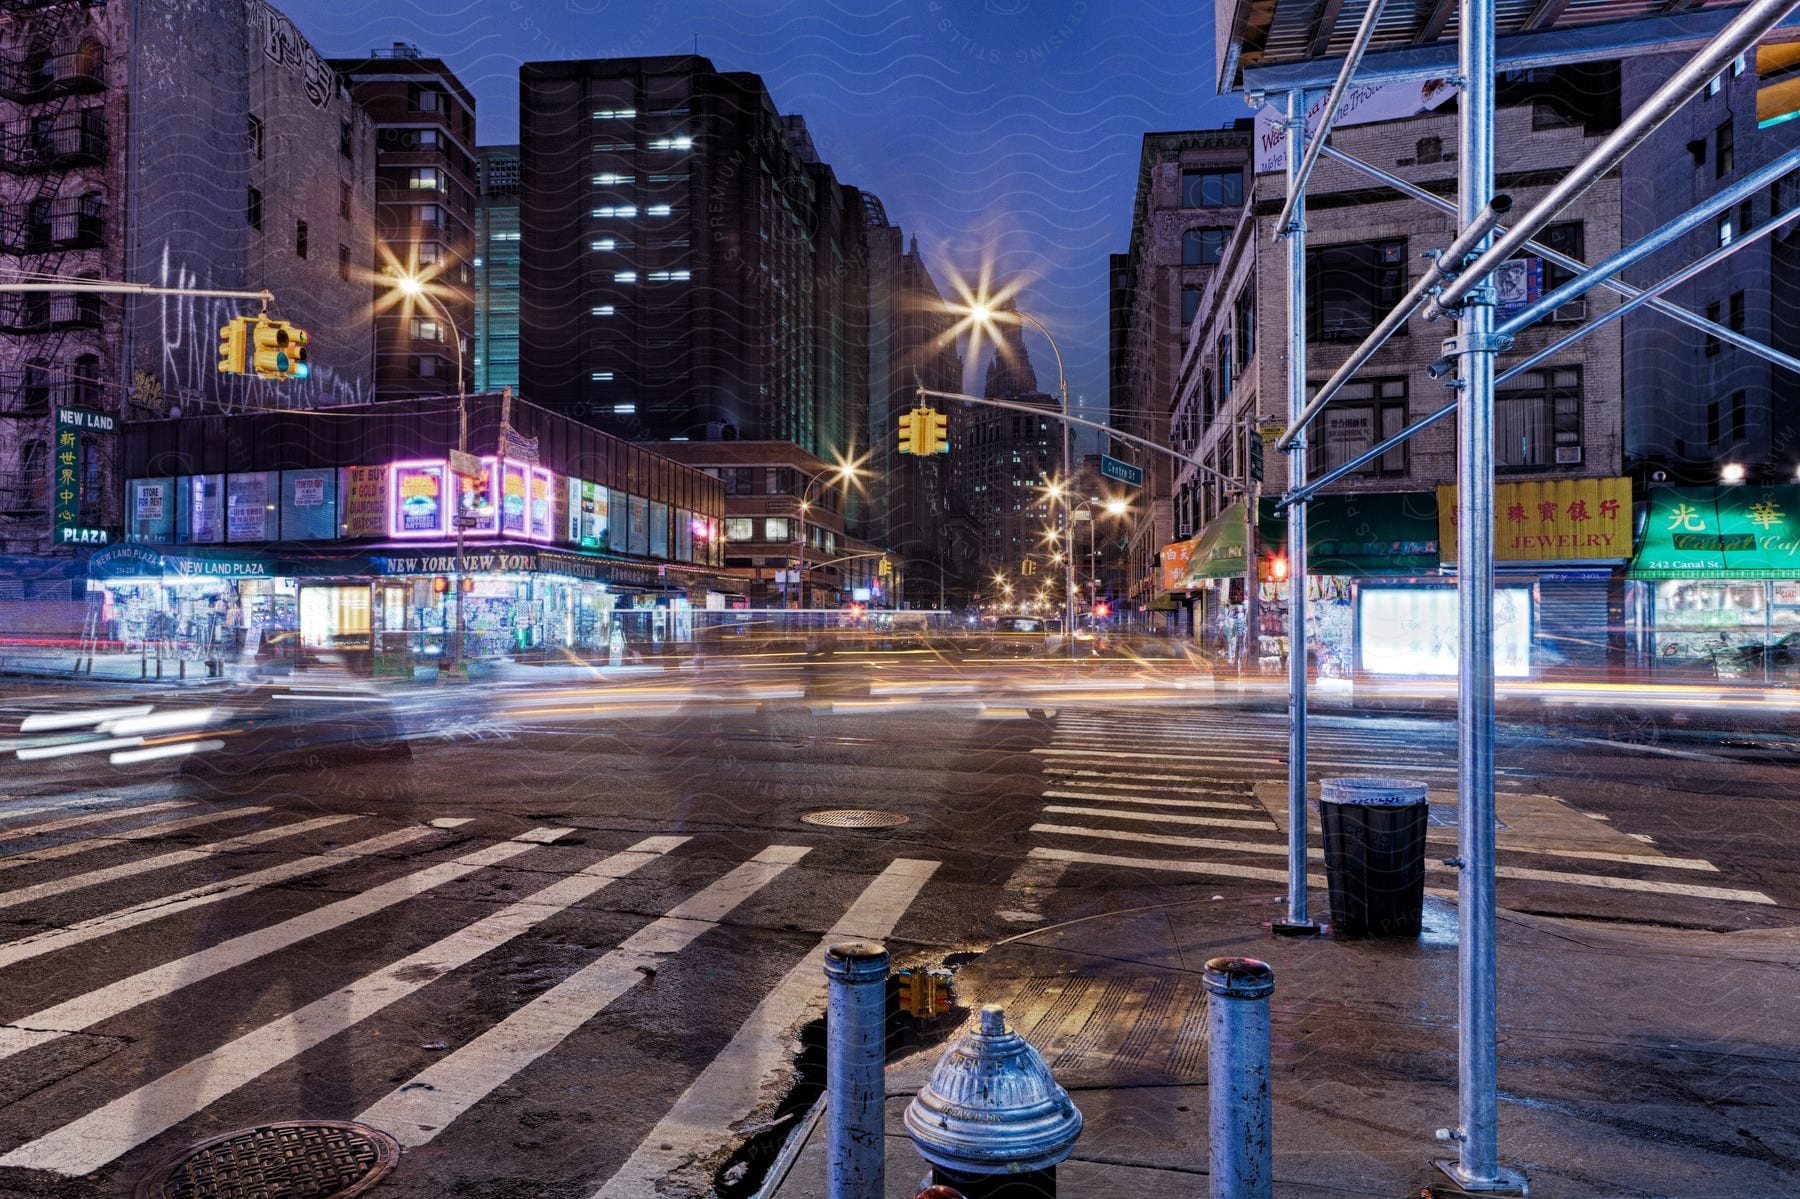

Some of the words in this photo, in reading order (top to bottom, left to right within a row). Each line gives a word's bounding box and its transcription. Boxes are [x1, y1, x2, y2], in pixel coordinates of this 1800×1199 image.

[60, 409, 83, 426] NEW
[87, 413, 113, 430] LAND
[58, 430, 77, 520] 新世界中心
[352, 468, 365, 482] WE
[367, 468, 386, 481] BUY
[1107, 462, 1128, 478] Centre
[1128, 469, 1136, 481] St
[143, 487, 159, 498] STORE
[359, 484, 378, 498] GOLD
[63, 527, 108, 544] PLAZA
[1511, 533, 1616, 548] JEWELRY
[95, 551, 111, 566] NEW
[112, 547, 132, 560] LAND
[133, 549, 157, 565] PLAZA
[387, 558, 418, 573] NEW
[420, 556, 457, 572] YORK
[463, 555, 495, 570] NEW
[499, 554, 537, 571] YORK
[1649, 560, 1670, 569] 242
[1672, 560, 1705, 569] Canal
[180, 560, 203, 574] NEW
[205, 562, 231, 574] LAND
[233, 563, 264, 574] PLAZA
